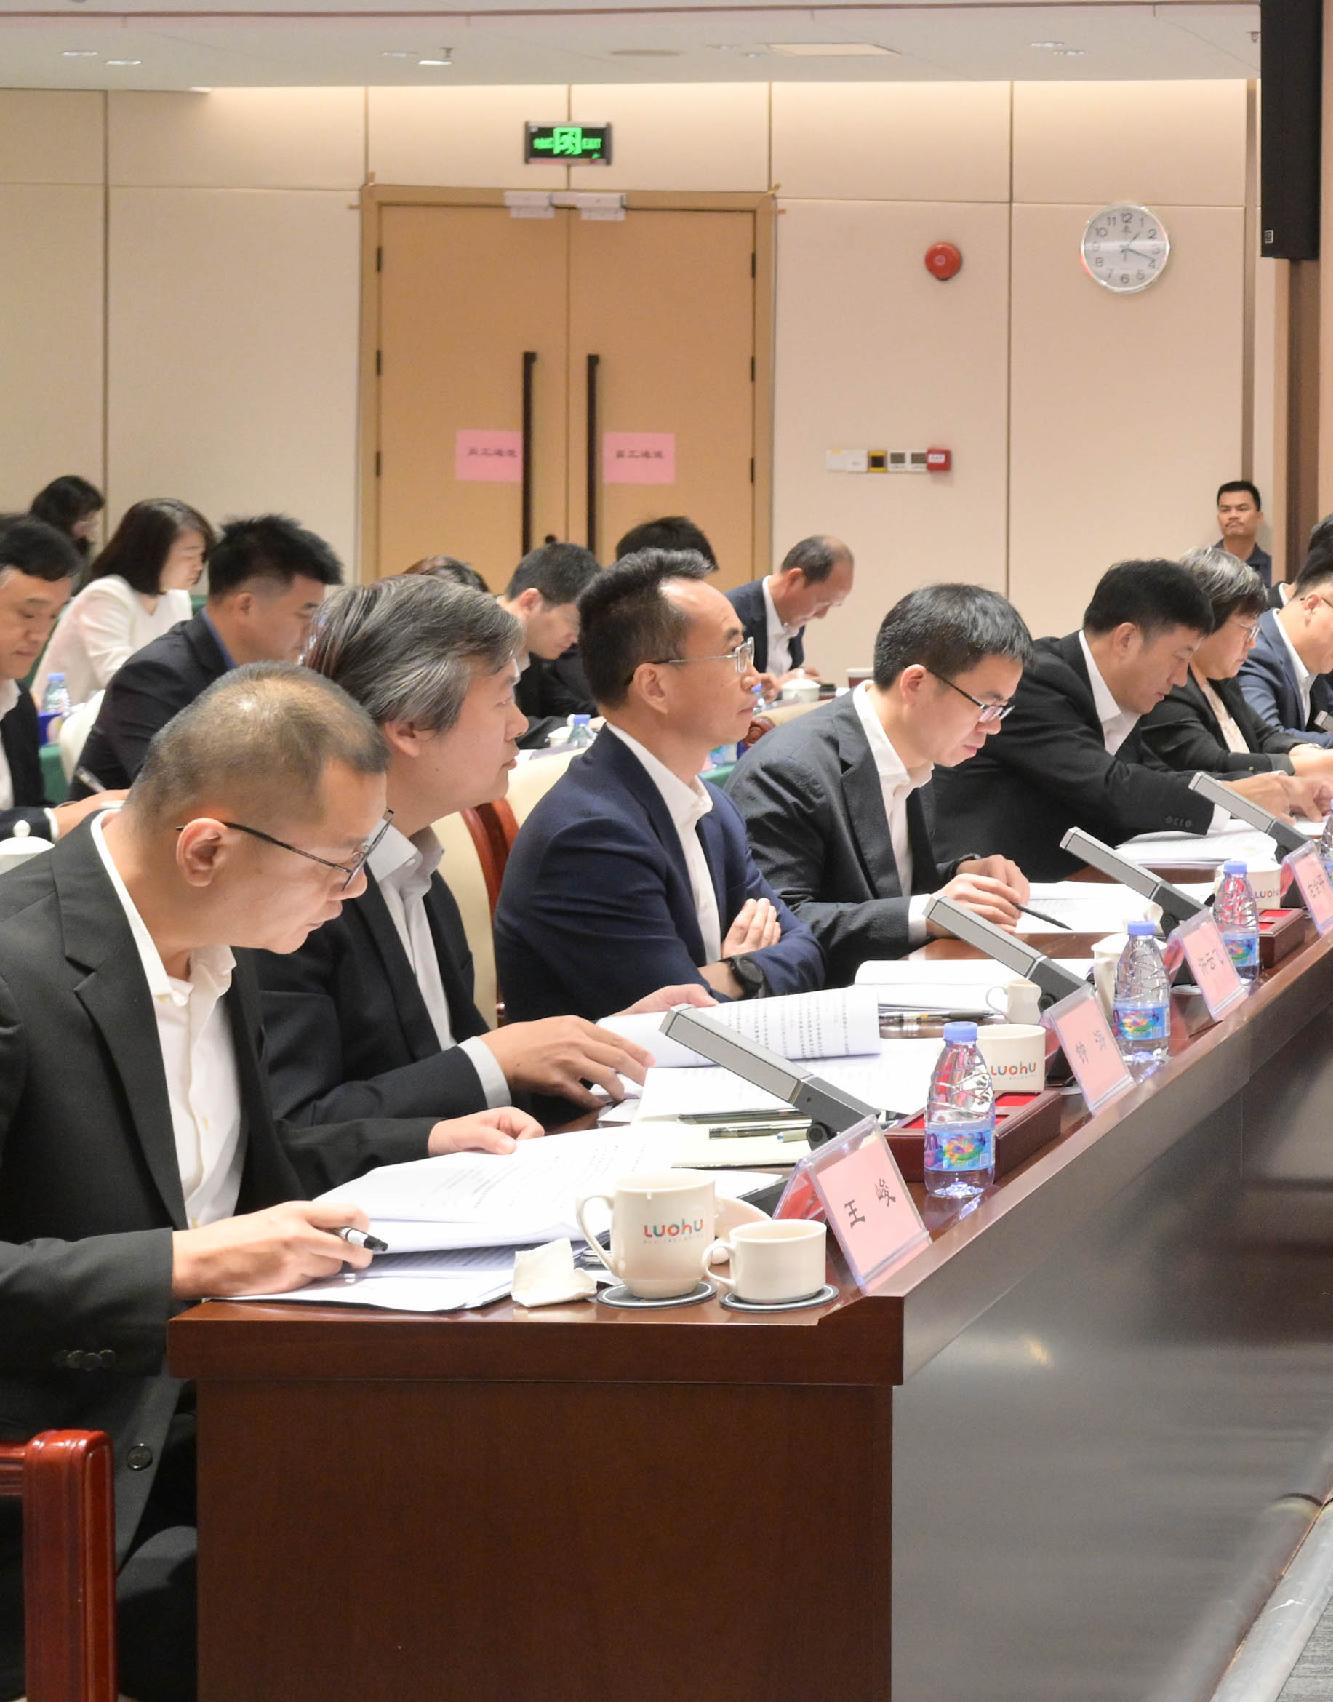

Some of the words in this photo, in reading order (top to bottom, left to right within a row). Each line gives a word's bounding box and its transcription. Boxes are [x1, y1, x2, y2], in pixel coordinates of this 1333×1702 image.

[1107, 216, 1117, 226] 11
[1121, 212, 1133, 224] 12
[1147, 229, 1157, 240] 2
[1120, 273, 1130, 284] 6
